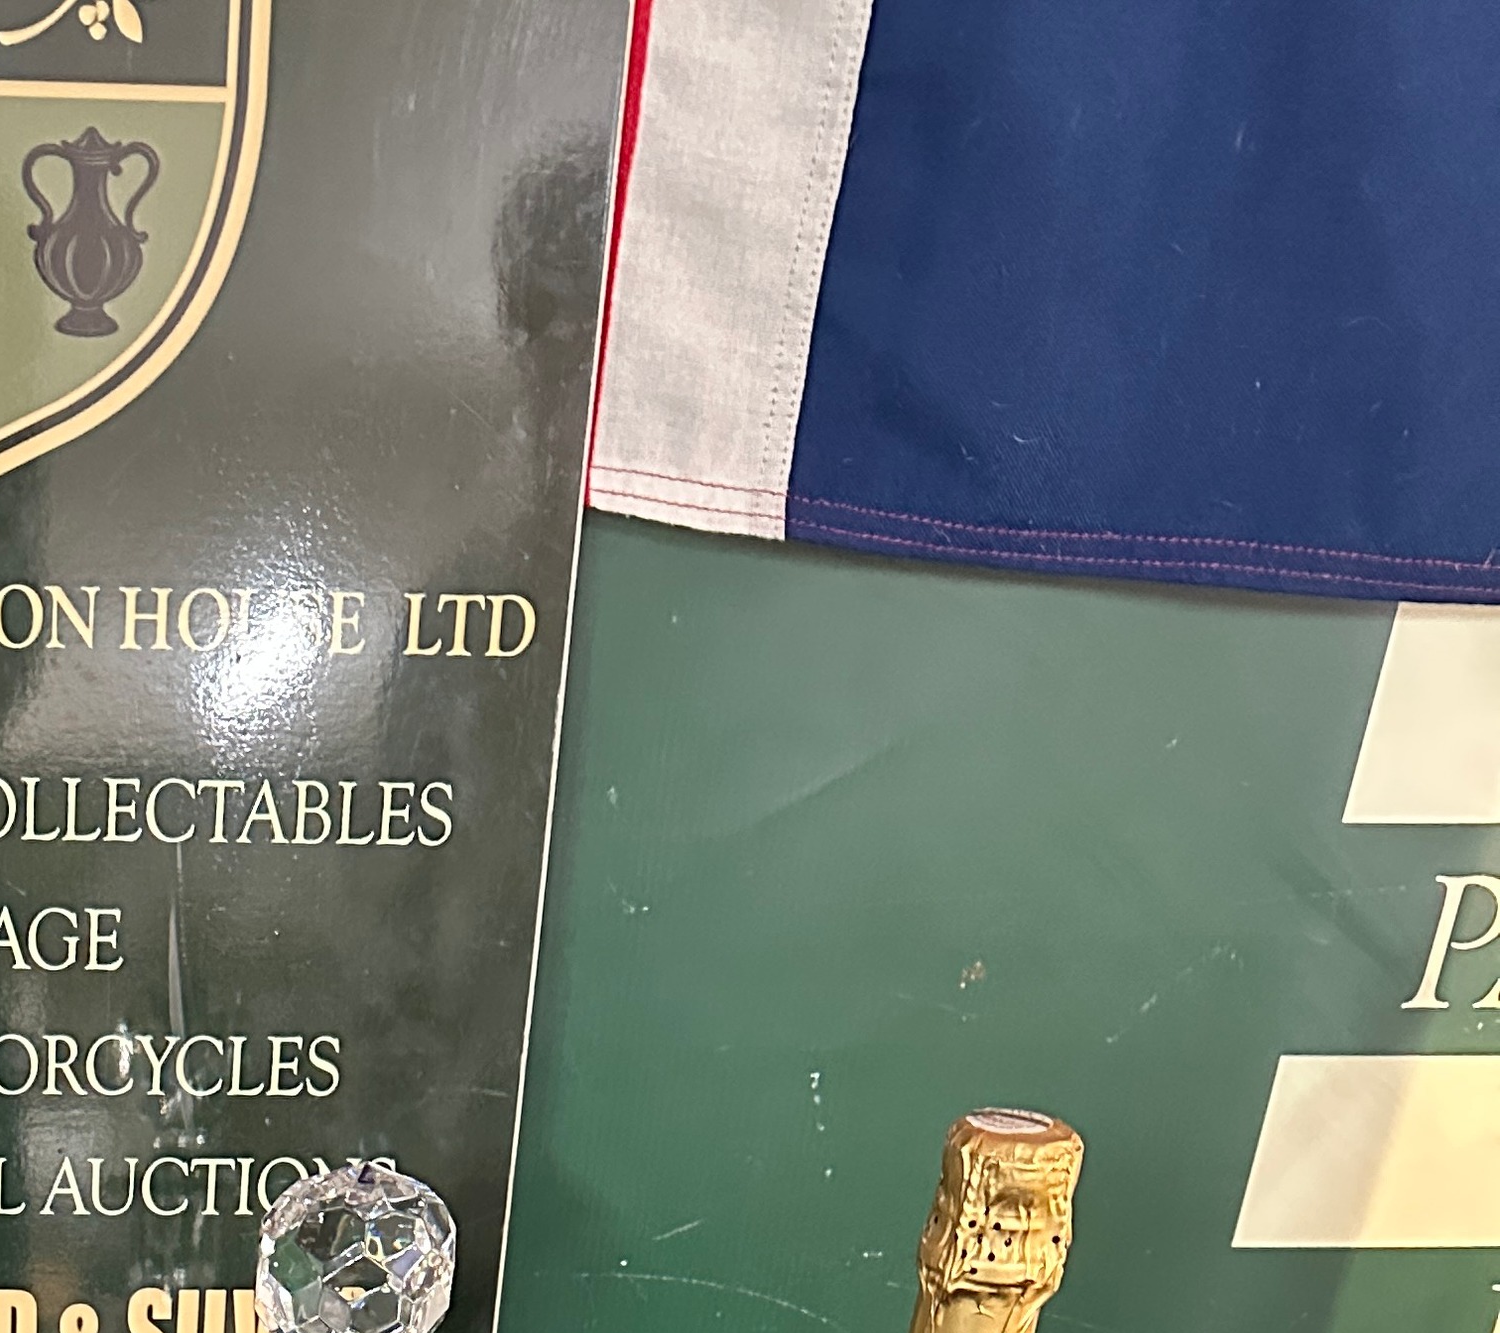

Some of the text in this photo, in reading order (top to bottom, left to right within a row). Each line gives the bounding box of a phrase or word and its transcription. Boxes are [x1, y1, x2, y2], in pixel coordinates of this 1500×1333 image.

[119, 584, 367, 656] HOE
[403, 592, 537, 657] LTD
[41, 1156, 396, 1217] AUCTIO
